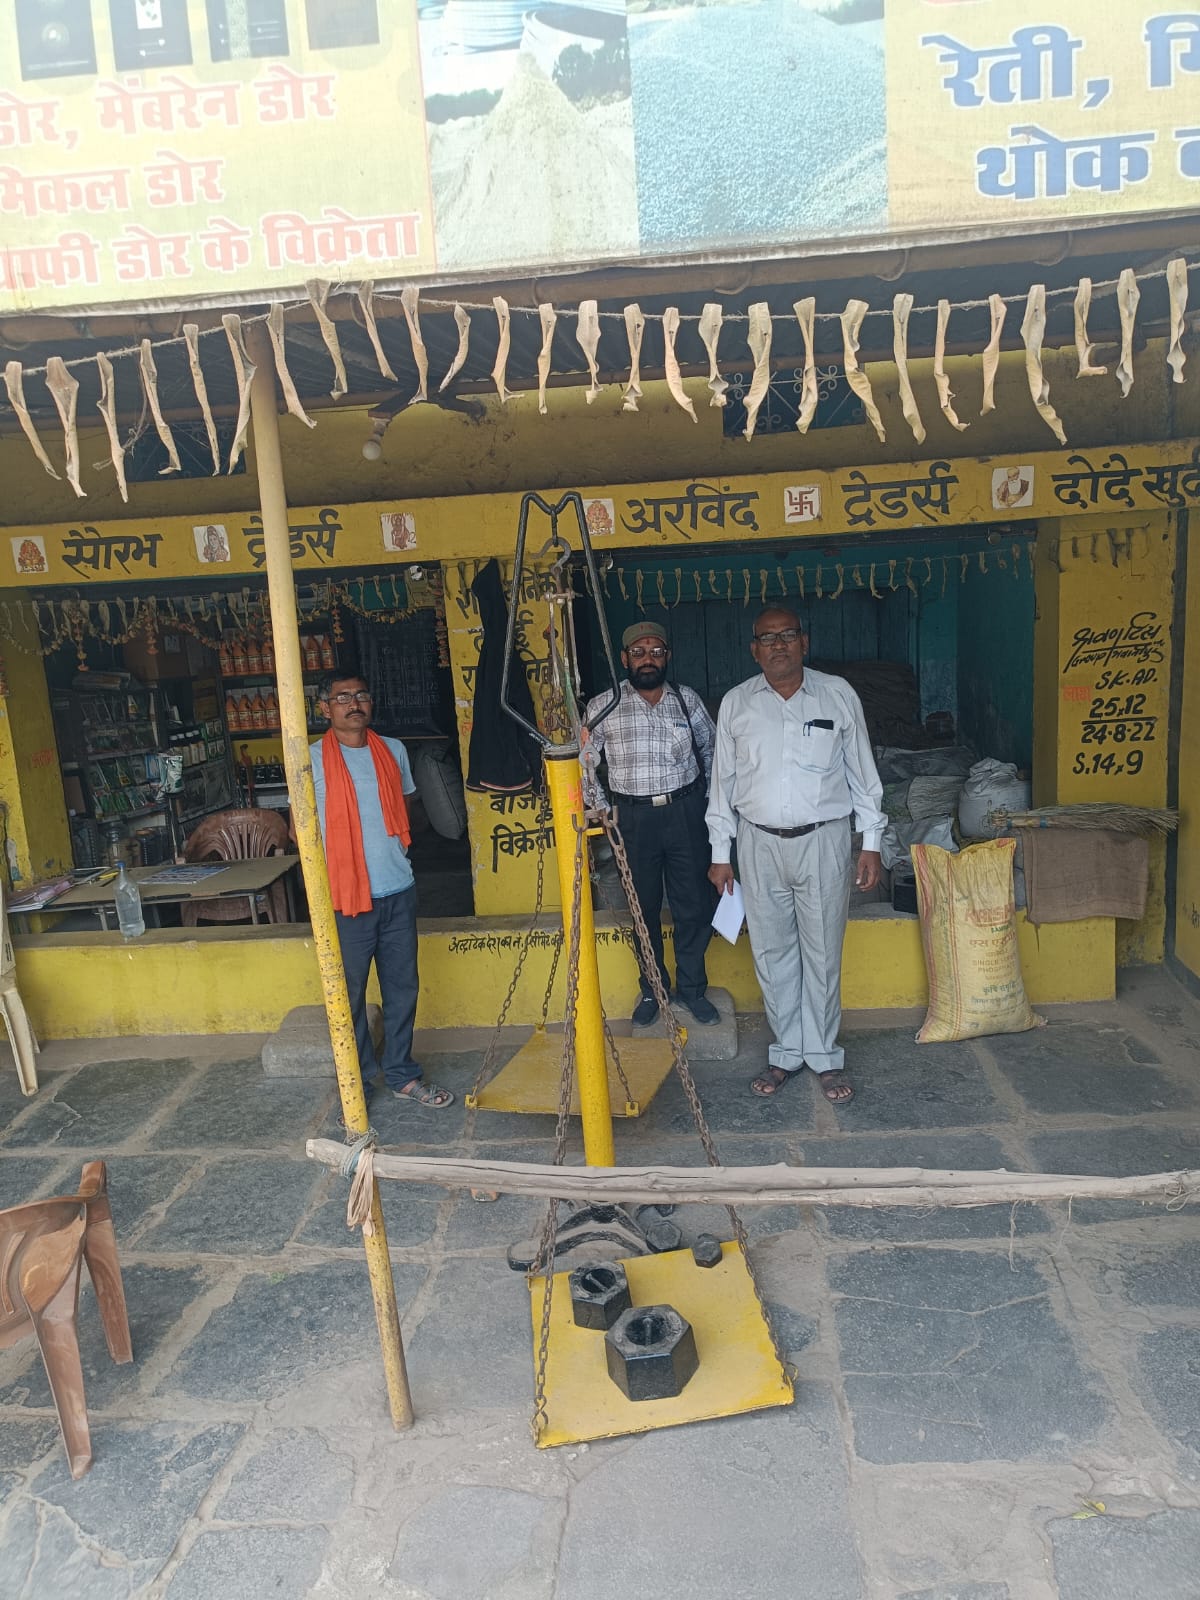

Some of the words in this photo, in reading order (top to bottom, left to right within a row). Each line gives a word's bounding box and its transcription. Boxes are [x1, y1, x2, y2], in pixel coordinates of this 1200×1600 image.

[97, 76, 240, 134] मेंबरेन
[255, 65, 335, 122] डोर
[920, 24, 1111, 108] रेती,
[144, 151, 224, 207] डोर
[976, 124, 1155, 200] थोक
[112, 227, 191, 282] डोर
[200, 219, 250, 271] के
[263, 208, 420, 268] विक्रेता
[620, 483, 760, 540] अरविंद
[841, 461, 960, 523] ट्रेडर्स
[490, 822, 557, 873] विक्रेता
